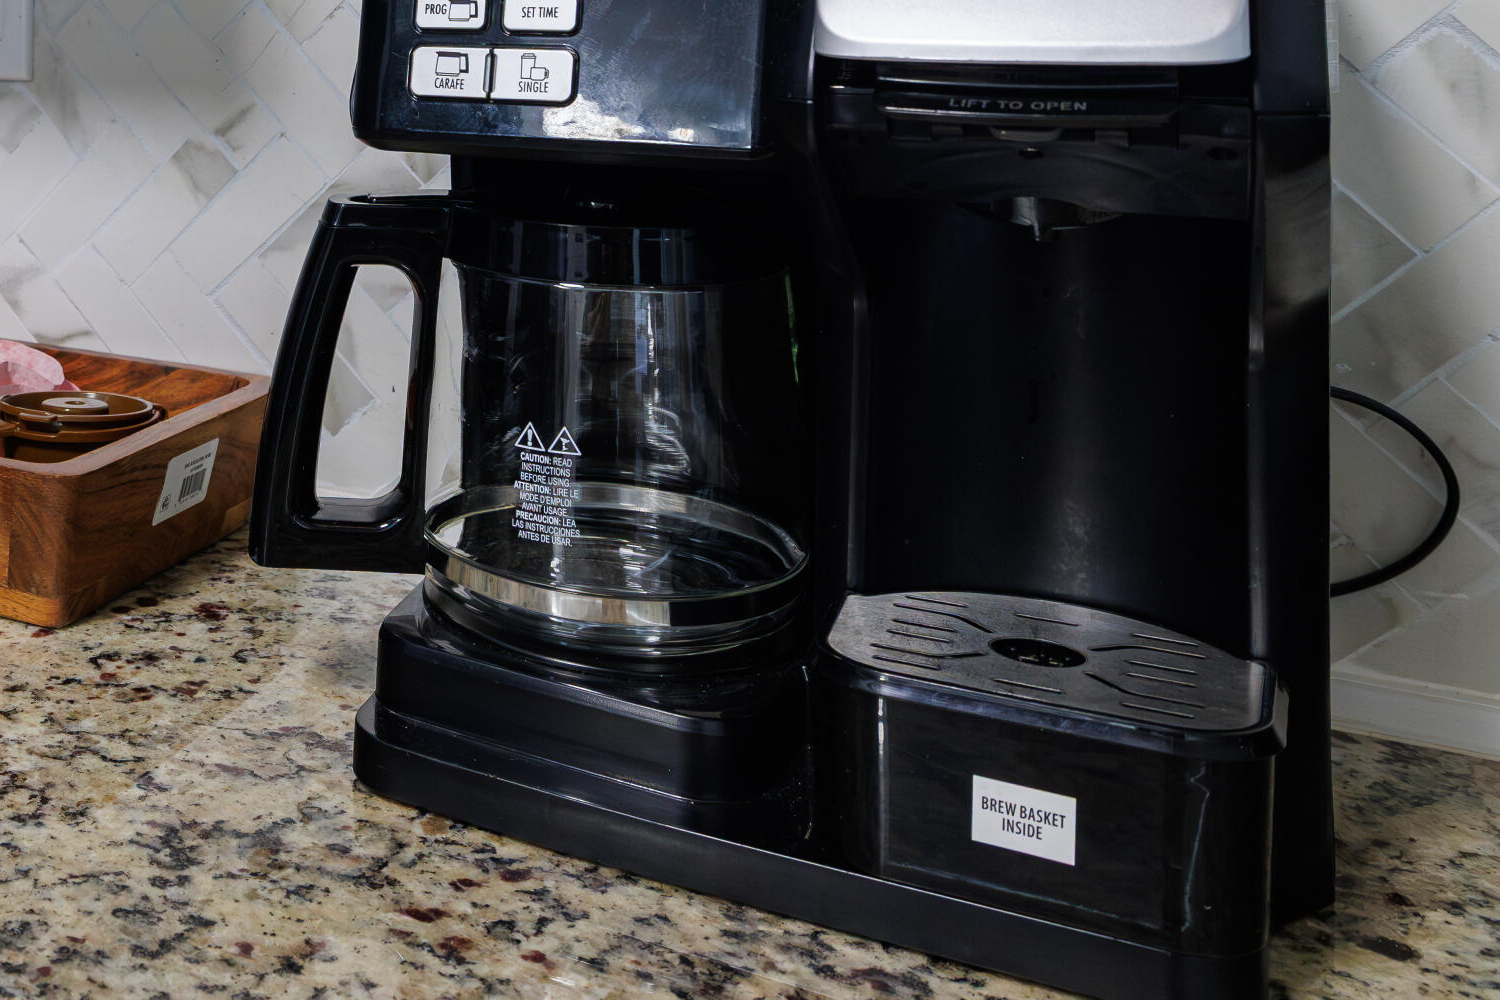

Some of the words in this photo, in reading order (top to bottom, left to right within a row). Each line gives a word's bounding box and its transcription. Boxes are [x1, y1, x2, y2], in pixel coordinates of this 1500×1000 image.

[424, 3, 448, 15] PROG
[521, 6, 536, 19] SET
[538, 6, 559, 18] TIME
[434, 78, 465, 90] CARAFE
[518, 81, 549, 93] SINGLE
[949, 98, 990, 109] LIFT
[997, 100, 1023, 110] TO
[1030, 101, 1088, 111] OPEN
[520, 452, 552, 465] CAUTION:
[553, 457, 573, 467] READ
[521, 461, 571, 478] INSTRUCTIONS
[520, 471, 546, 485] BEFORE
[547, 476, 572, 488] USING.
[514, 480, 552, 494] ATTENTION:
[553, 487, 569, 498] LIRE
[570, 489, 579, 499] LE
[519, 491, 539, 503] MODE
[540, 494, 572, 508] D'EMPLOI
[521, 502, 542, 513] AVANT
[512, 518, 524, 528] LAS
[525, 520, 580, 537] INSTRUCCIONES
[515, 510, 561, 526] PRECAUCION:
[562, 518, 577, 528] LEA
[518, 530, 539, 542] ANTES
[540, 534, 550, 544] DE
[551, 536, 573, 547] USAR.
[981, 795, 1017, 817] BREW
[1019, 805, 1066, 829] BASKET
[1002, 817, 1043, 841] INSIDE
